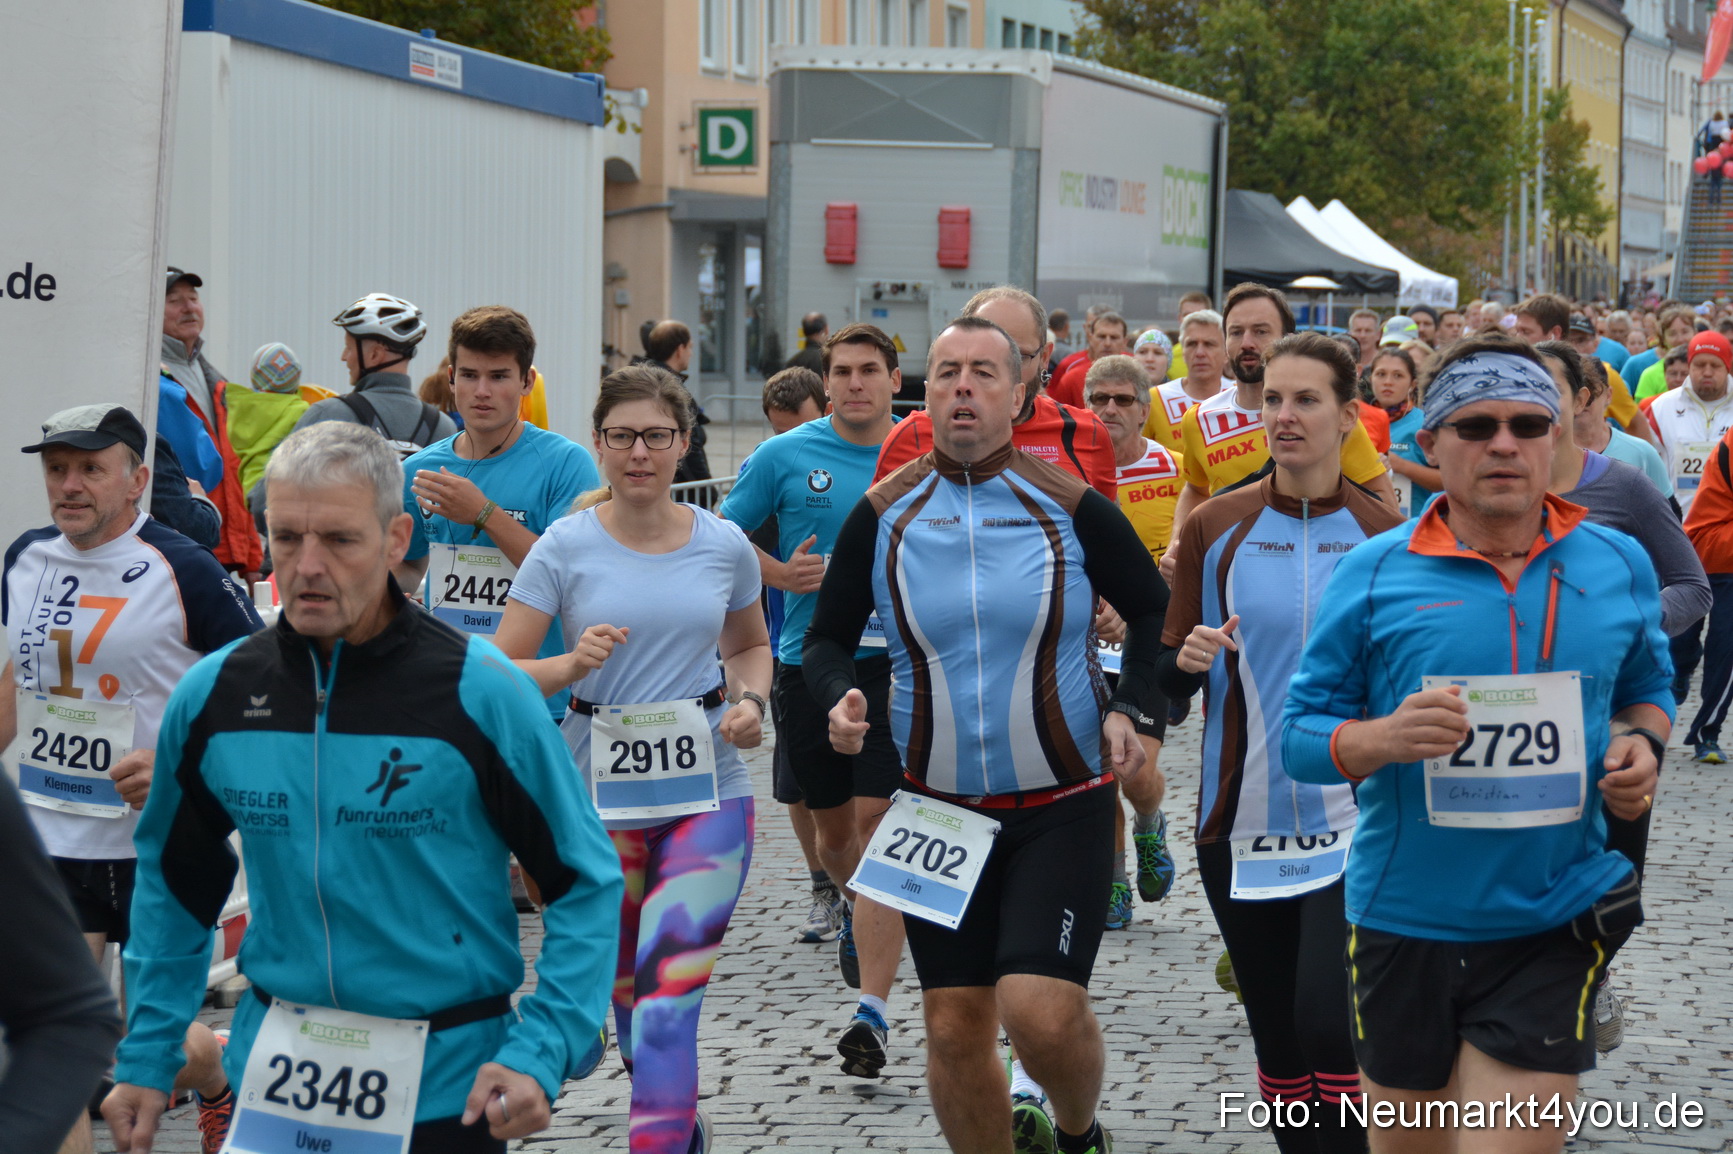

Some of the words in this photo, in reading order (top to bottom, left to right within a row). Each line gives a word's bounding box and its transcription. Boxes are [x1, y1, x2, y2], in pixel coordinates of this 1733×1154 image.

[707, 116, 748, 159] D
[1059, 169, 1084, 209] OFFICE
[1085, 174, 1118, 212] INDUSTRY
[1119, 179, 1147, 215] LOUNGE
[1161, 164, 1209, 249] BOCK
[1207, 439, 1256, 467] MAX
[1128, 484, 1178, 503] BÖGL
[982, 518, 995, 527] BIO
[467, 554, 501, 566] BOCK
[444, 573, 513, 606] 2442
[33, 594, 54, 647] LAUF
[463, 614, 492, 627] David
[1483, 688, 1537, 702] BOCK
[57, 706, 96, 721] BOCK
[243, 708, 272, 718] erima
[635, 712, 677, 724] BOCK
[31, 727, 112, 772] 2420
[610, 735, 697, 774] 2918
[1449, 720, 1561, 768] 2729
[44, 776, 93, 795] Klemens
[1449, 786, 1520, 800] Christian
[223, 787, 289, 809] STIEGLER
[334, 806, 434, 826] funrunners
[925, 809, 963, 829] BOCK
[364, 820, 448, 840] neumarkt
[883, 828, 968, 880] 2702
[1279, 864, 1310, 877] Silvia
[901, 879, 922, 894] Jim
[1059, 908, 1075, 955] 2XU
[311, 1022, 370, 1044] BOCK
[264, 1054, 388, 1120] 2348
[295, 1130, 332, 1153] Uwe
